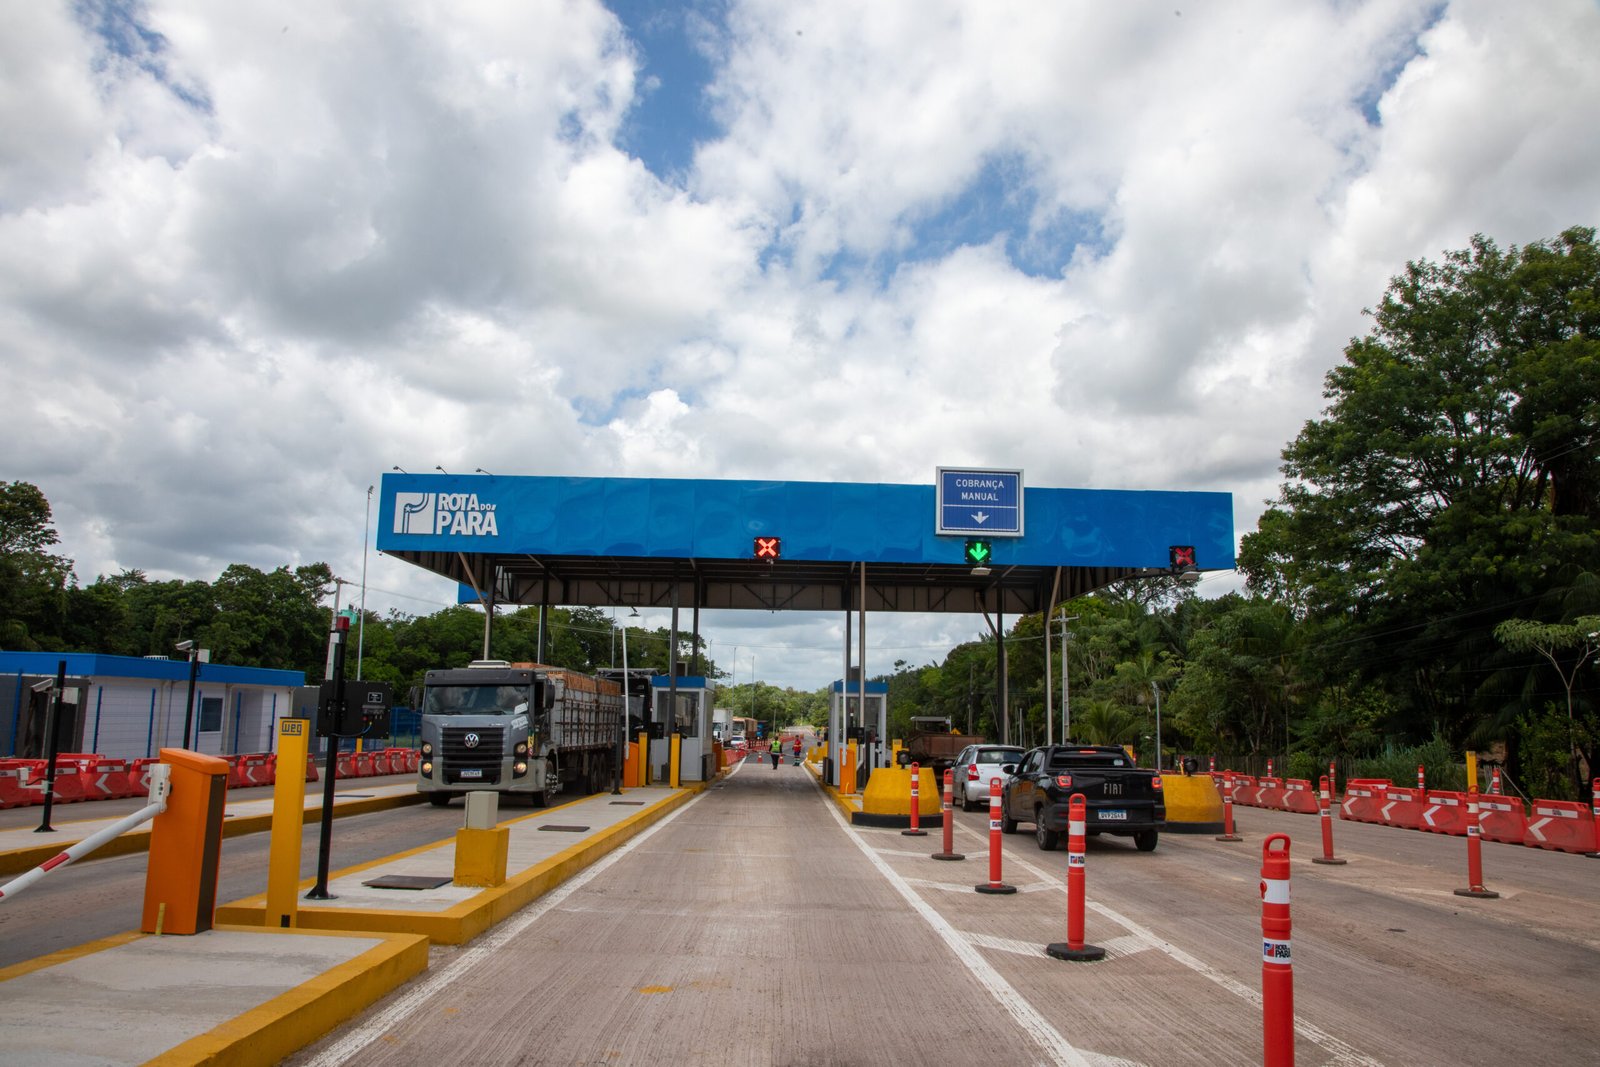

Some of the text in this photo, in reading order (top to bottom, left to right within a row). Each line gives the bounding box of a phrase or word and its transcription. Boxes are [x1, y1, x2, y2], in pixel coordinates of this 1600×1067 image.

[955, 478, 1005, 490] COBRANÇA
[438, 492, 480, 511] ROTA
[961, 491, 999, 501] MANUAL
[1103, 783, 1123, 795] FIAT
